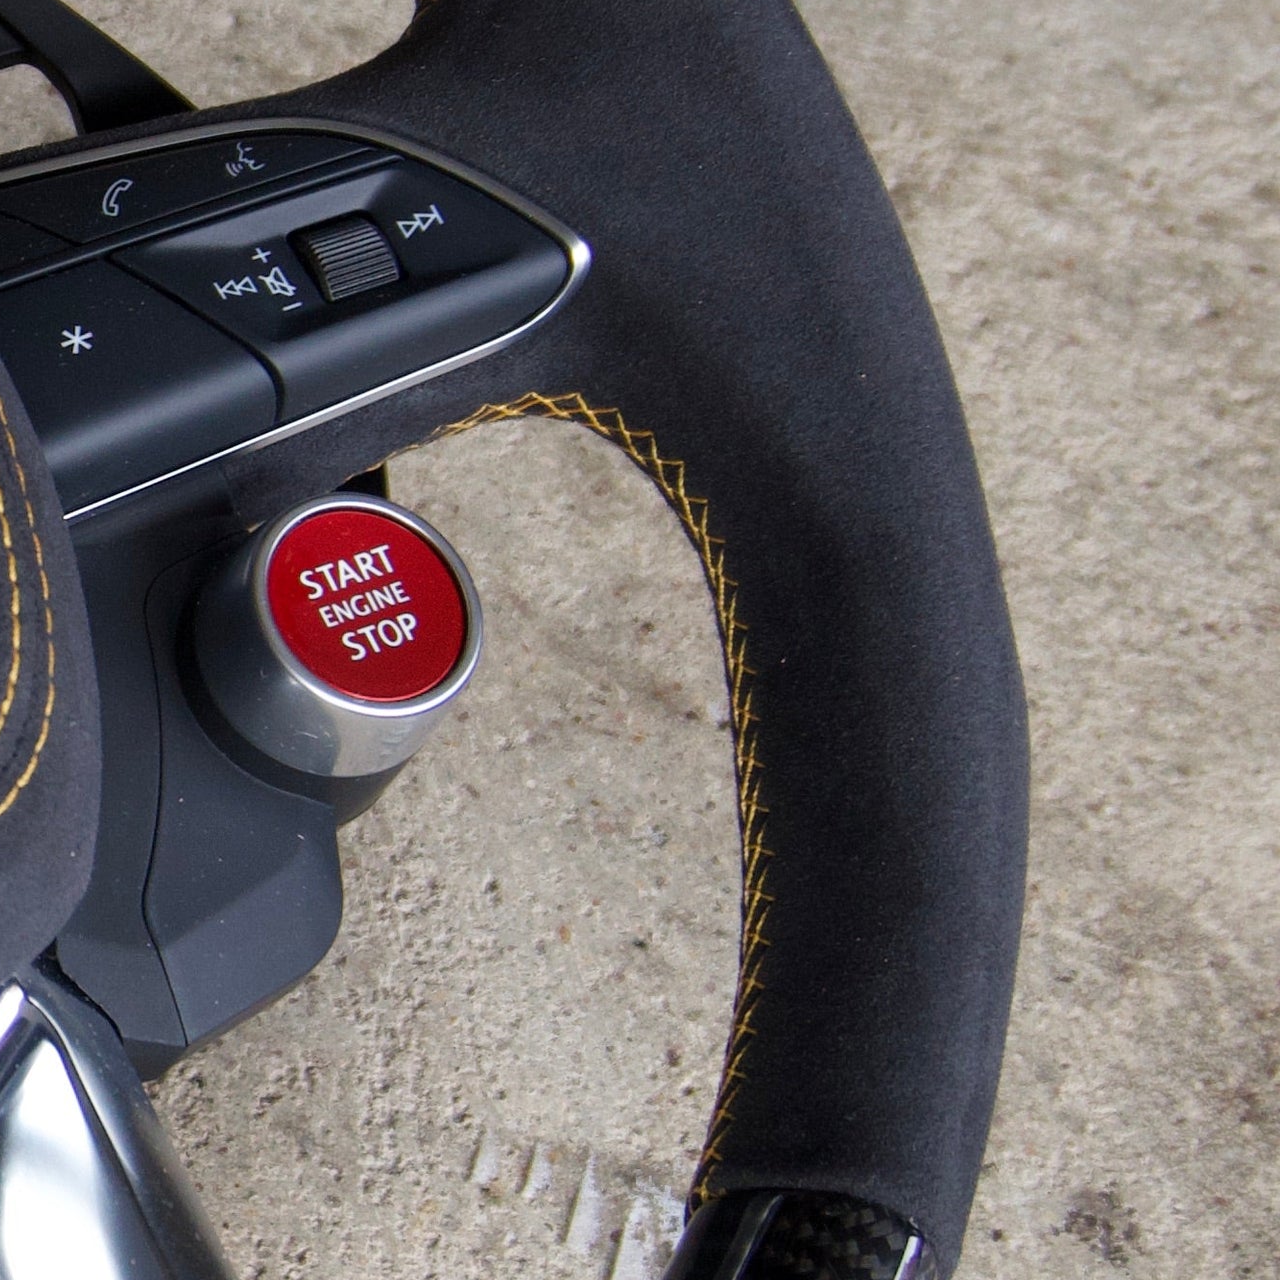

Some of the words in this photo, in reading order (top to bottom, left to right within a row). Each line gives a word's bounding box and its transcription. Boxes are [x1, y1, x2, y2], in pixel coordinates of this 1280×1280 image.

[299, 545, 394, 600] START
[318, 581, 410, 628] ENGINE
[341, 613, 418, 661] STOP
